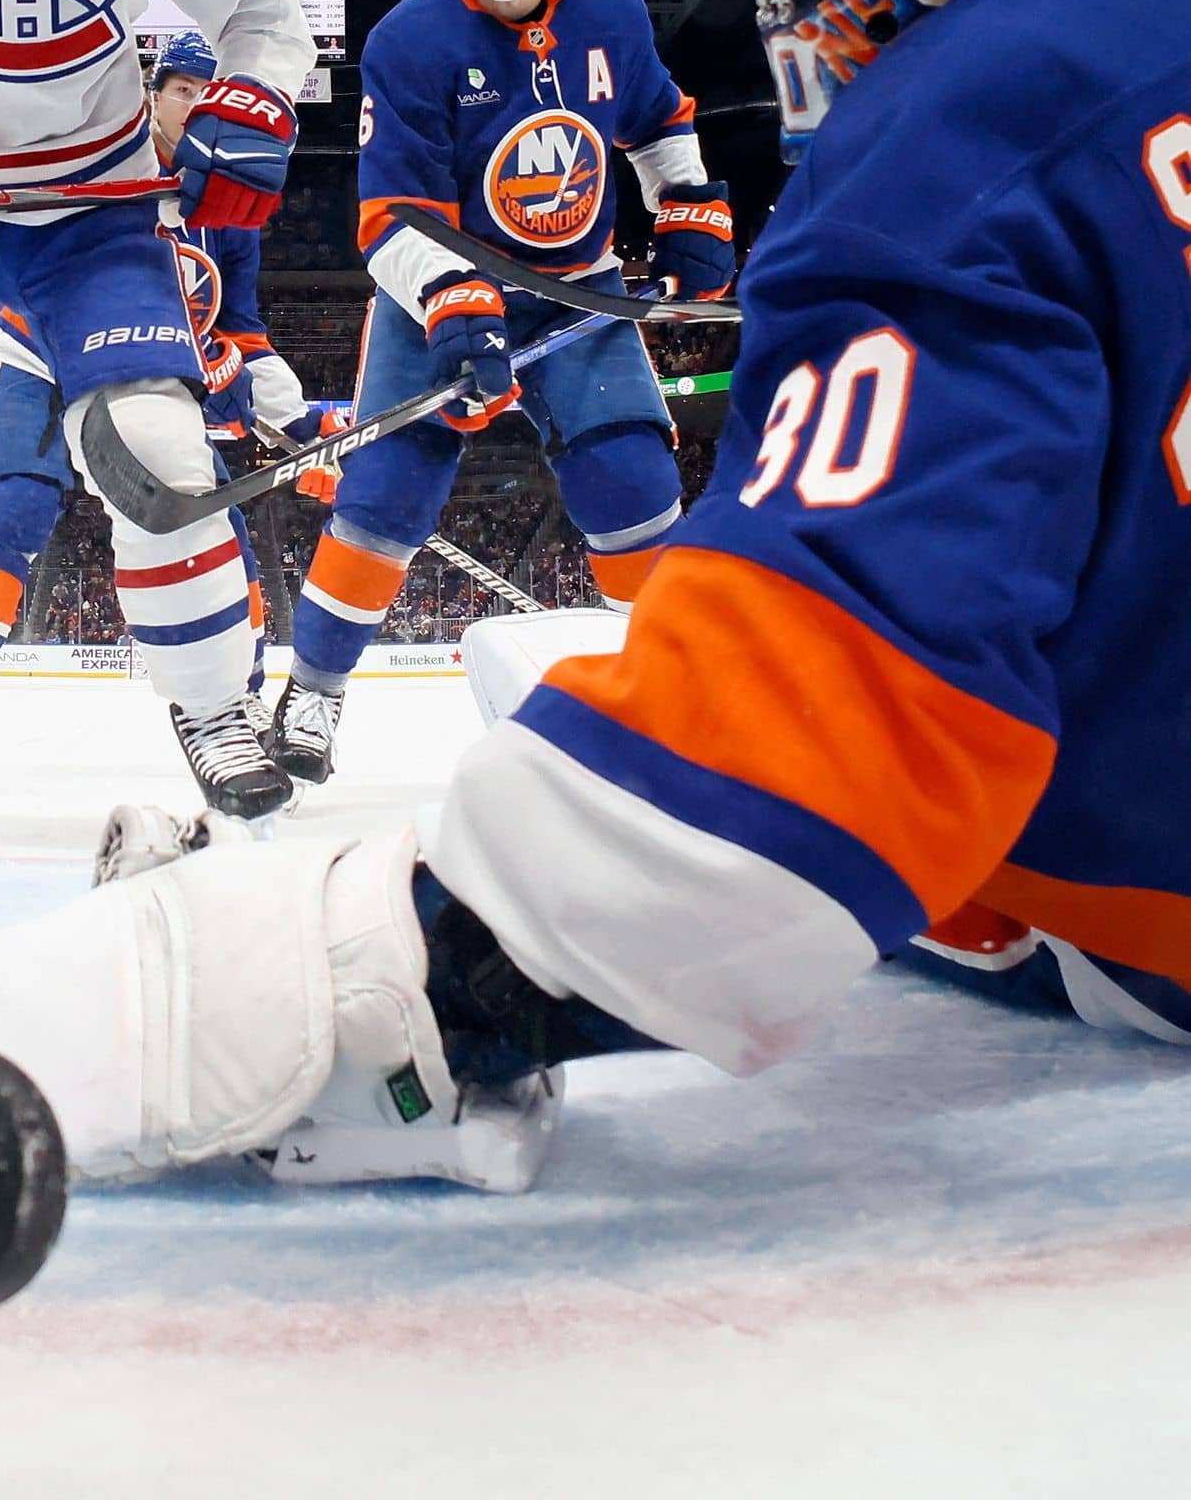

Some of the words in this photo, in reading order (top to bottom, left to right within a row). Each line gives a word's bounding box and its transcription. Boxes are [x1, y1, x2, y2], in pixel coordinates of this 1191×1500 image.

[587, 48, 613, 102] A
[196, 86, 282, 126] UER
[457, 88, 500, 104] VANDA
[358, 95, 374, 147] 6
[517, 124, 582, 176] NY
[504, 184, 596, 234] ISLANDERS
[656, 202, 733, 232] BAUER
[427, 287, 495, 317] UER
[82, 324, 195, 354] BAUER
[738, 326, 918, 509] 30
[72, 649, 143, 658] AMERICAN
[390, 654, 445, 666] Heineken
